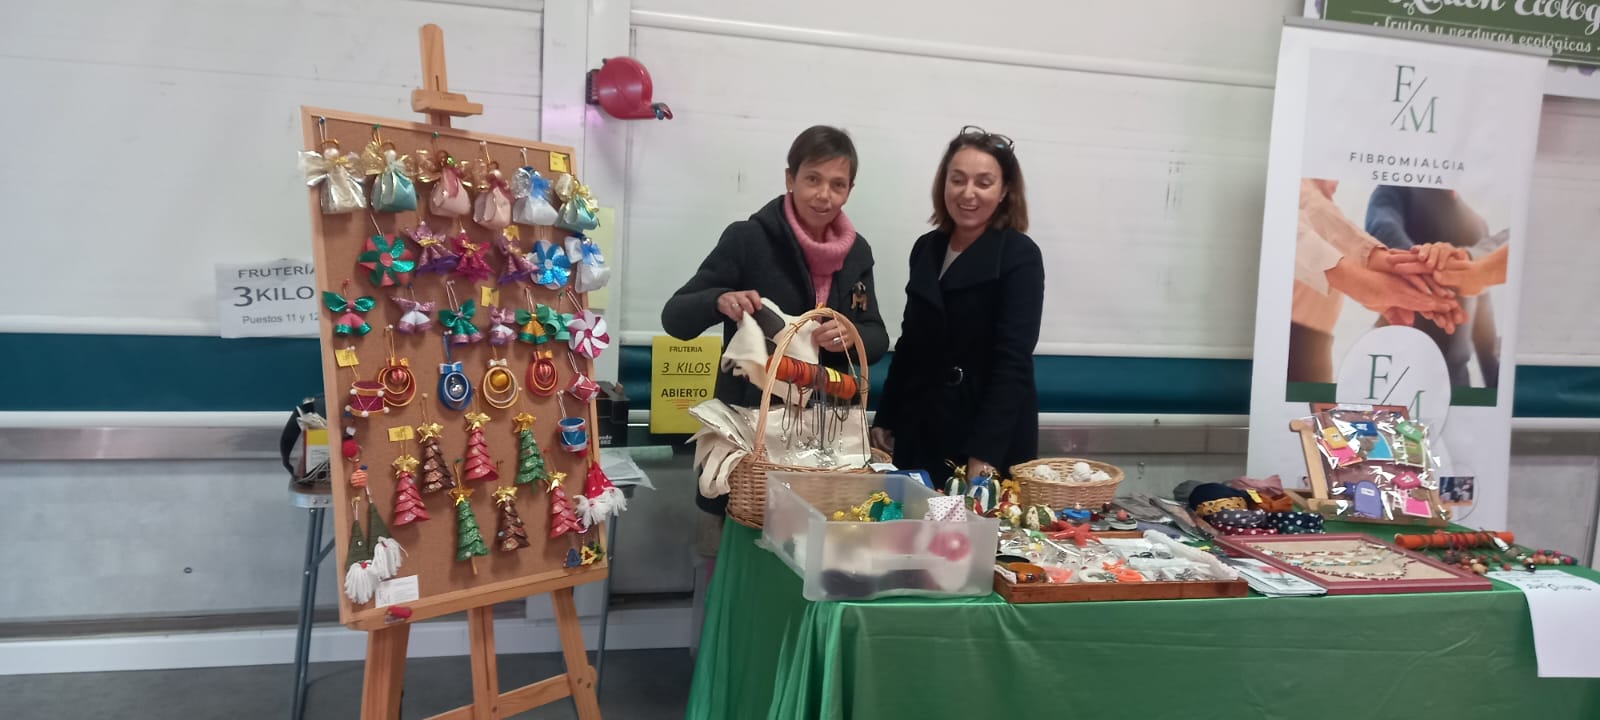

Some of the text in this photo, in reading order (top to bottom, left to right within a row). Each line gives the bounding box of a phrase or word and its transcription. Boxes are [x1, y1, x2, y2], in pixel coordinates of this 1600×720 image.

[1518, 34, 1592, 55] ecológicas
[1350, 152, 1465, 171] FIBROMIALGIA
[1372, 170, 1443, 184] SEGOVIA
[242, 315, 283, 324] Puestos
[299, 315, 305, 323] y
[661, 362, 711, 374] 3 KILOS
[661, 388, 708, 398] ABIERTO
